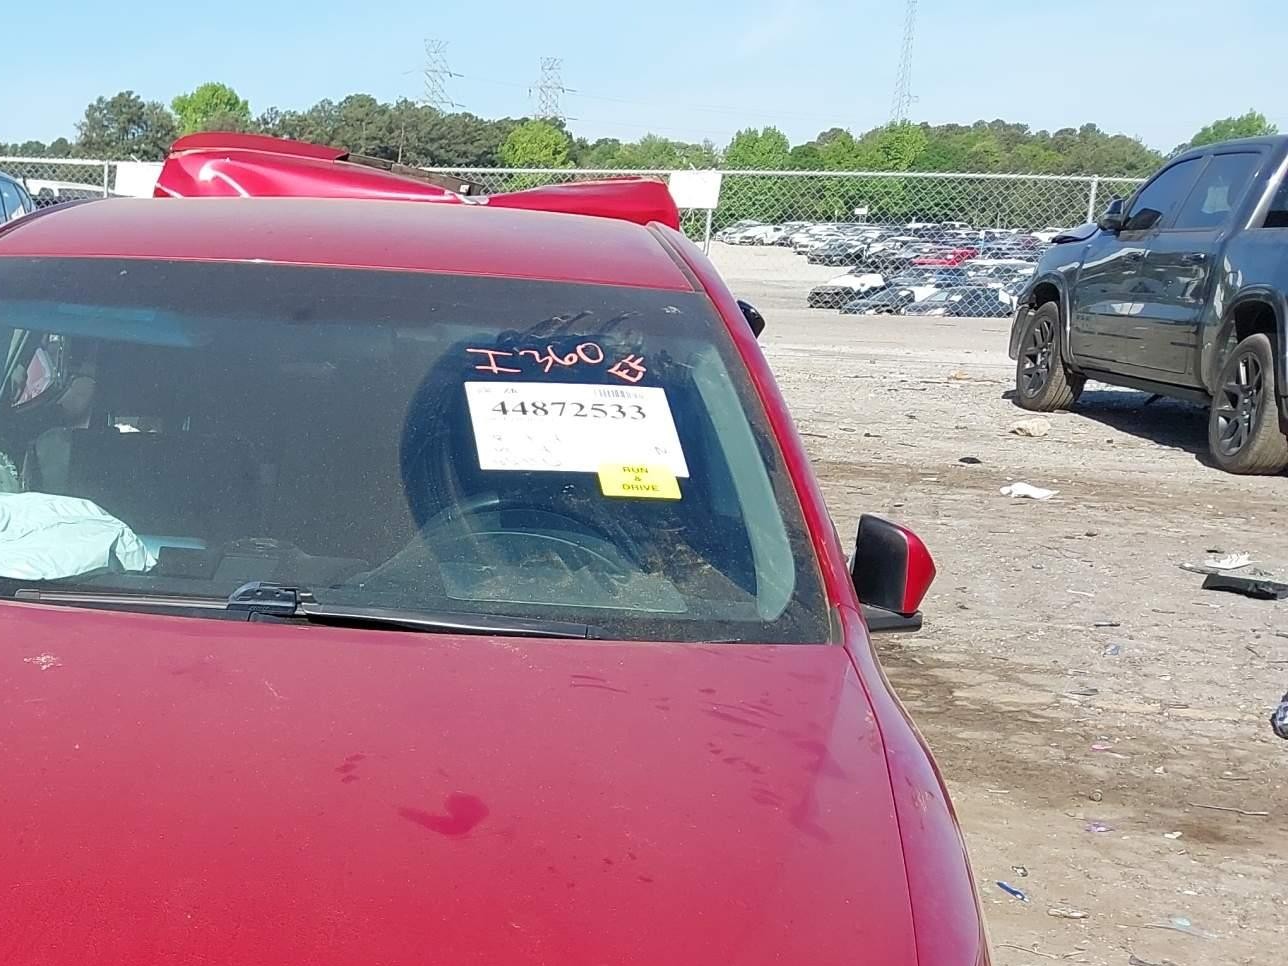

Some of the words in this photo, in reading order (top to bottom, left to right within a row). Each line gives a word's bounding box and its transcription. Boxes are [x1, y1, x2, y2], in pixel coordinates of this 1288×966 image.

[491, 400, 647, 421] 44872533
[622, 466, 649, 474] RUN
[622, 483, 660, 492] DRIVE
